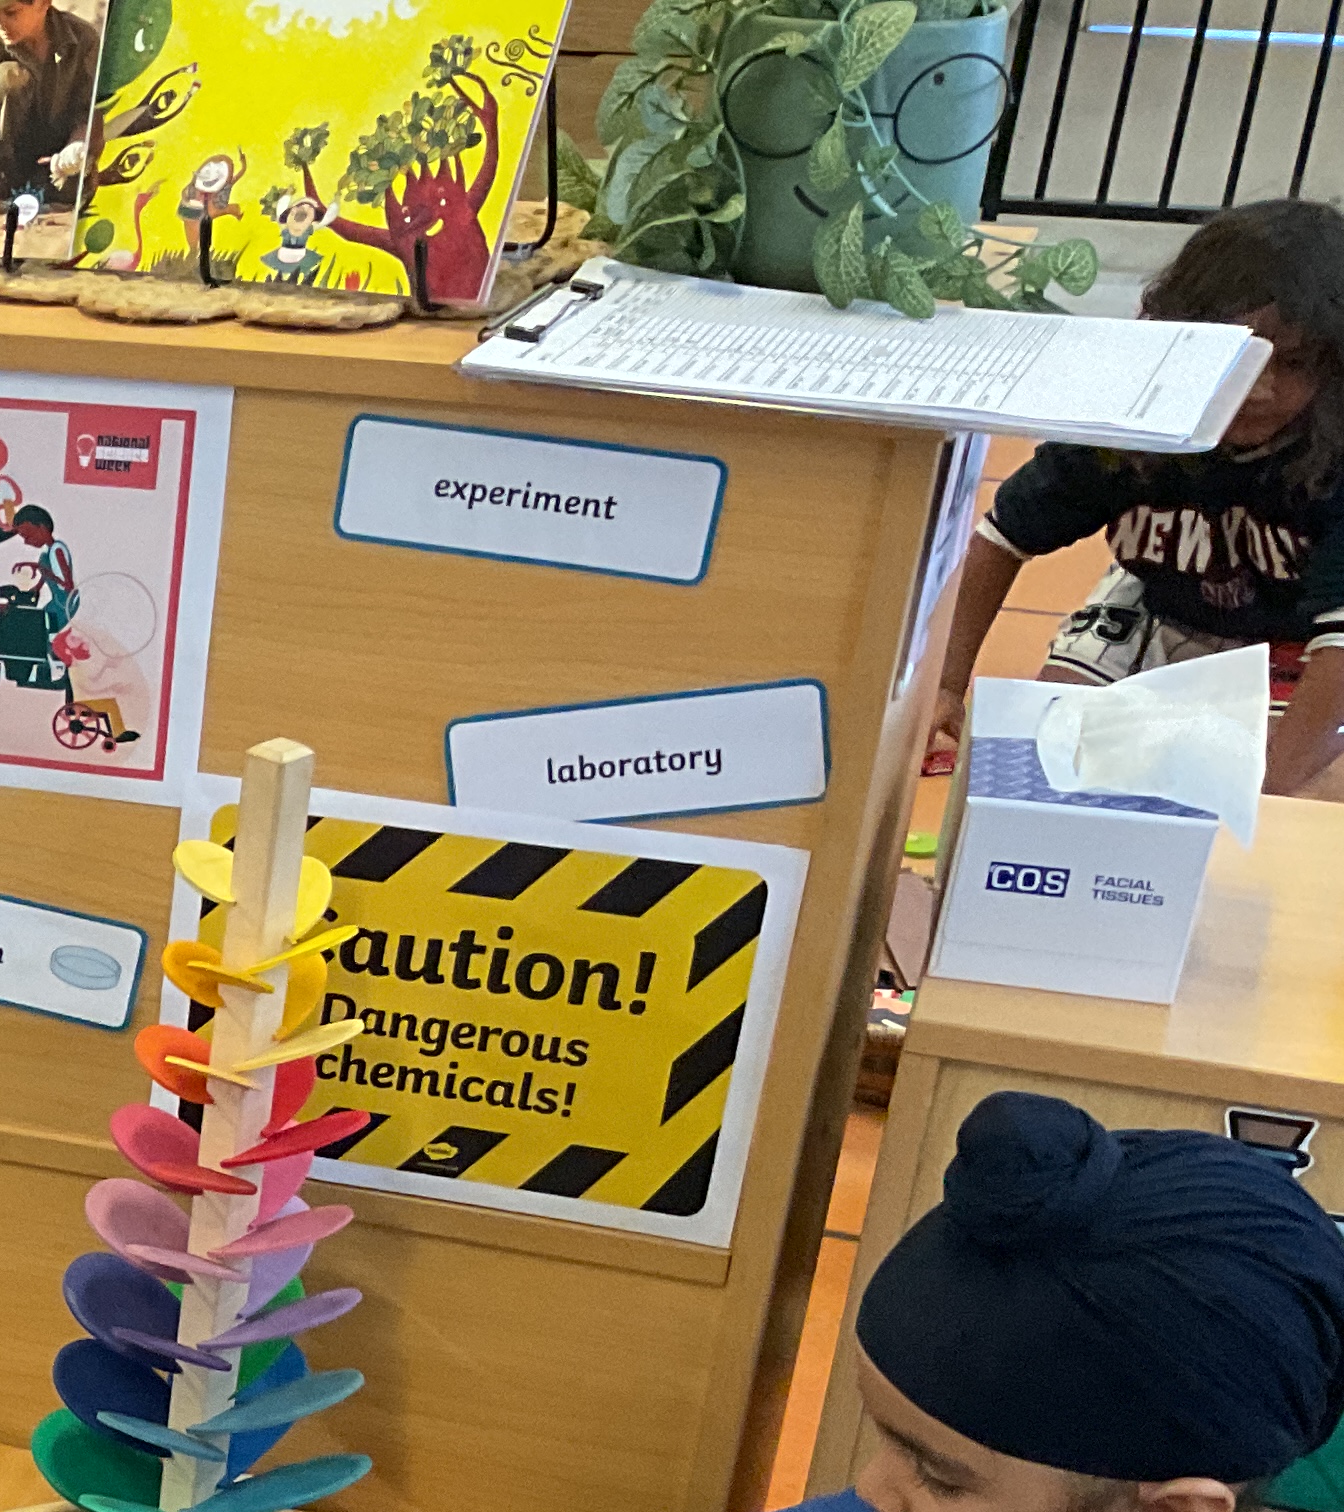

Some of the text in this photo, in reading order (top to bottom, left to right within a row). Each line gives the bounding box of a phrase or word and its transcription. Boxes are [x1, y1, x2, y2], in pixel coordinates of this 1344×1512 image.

[433, 472, 618, 522] experiment
[1110, 505, 1212, 573] NEW
[546, 742, 726, 785] laboratory
[990, 864, 1068, 896] COS
[1092, 888, 1164, 907] TISSUES
[1094, 874, 1155, 892] FACIAL
[322, 905, 657, 1018] aution!
[320, 992, 591, 1068] Dangerous
[315, 1043, 578, 1119] chemicals!
